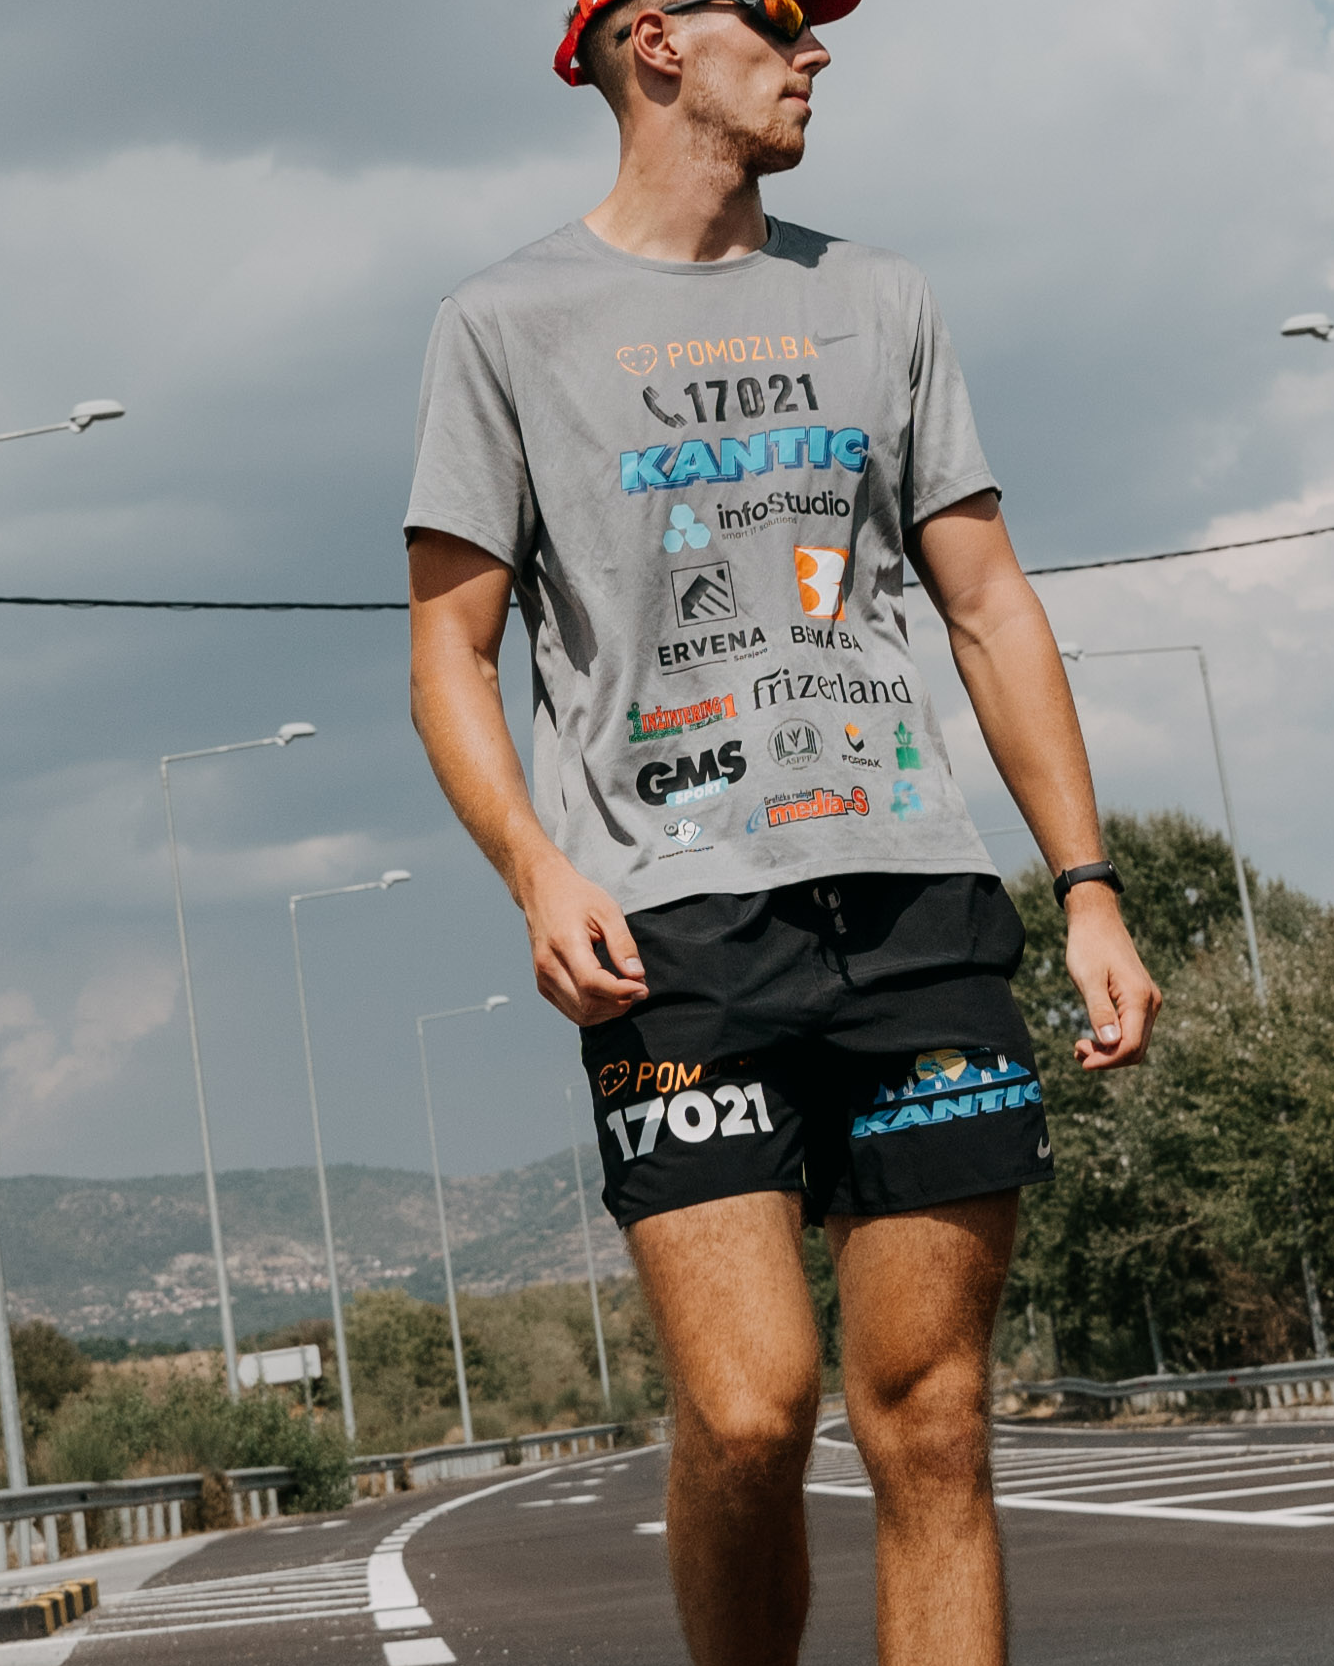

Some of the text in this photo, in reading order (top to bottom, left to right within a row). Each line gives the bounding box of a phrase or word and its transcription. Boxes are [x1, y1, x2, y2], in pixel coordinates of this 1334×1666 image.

[667, 336, 819, 368] POMOZI.BA
[684, 373, 819, 423] 17021
[620, 426, 869, 495] KANTIC
[717, 490, 851, 530] infoStudio
[658, 627, 766, 666] ERVENA
[636, 740, 747, 806] GMS
[675, 781, 722, 805] SPORT
[606, 1081, 774, 1162] 17021
[851, 1080, 1043, 1139] KANTIC
